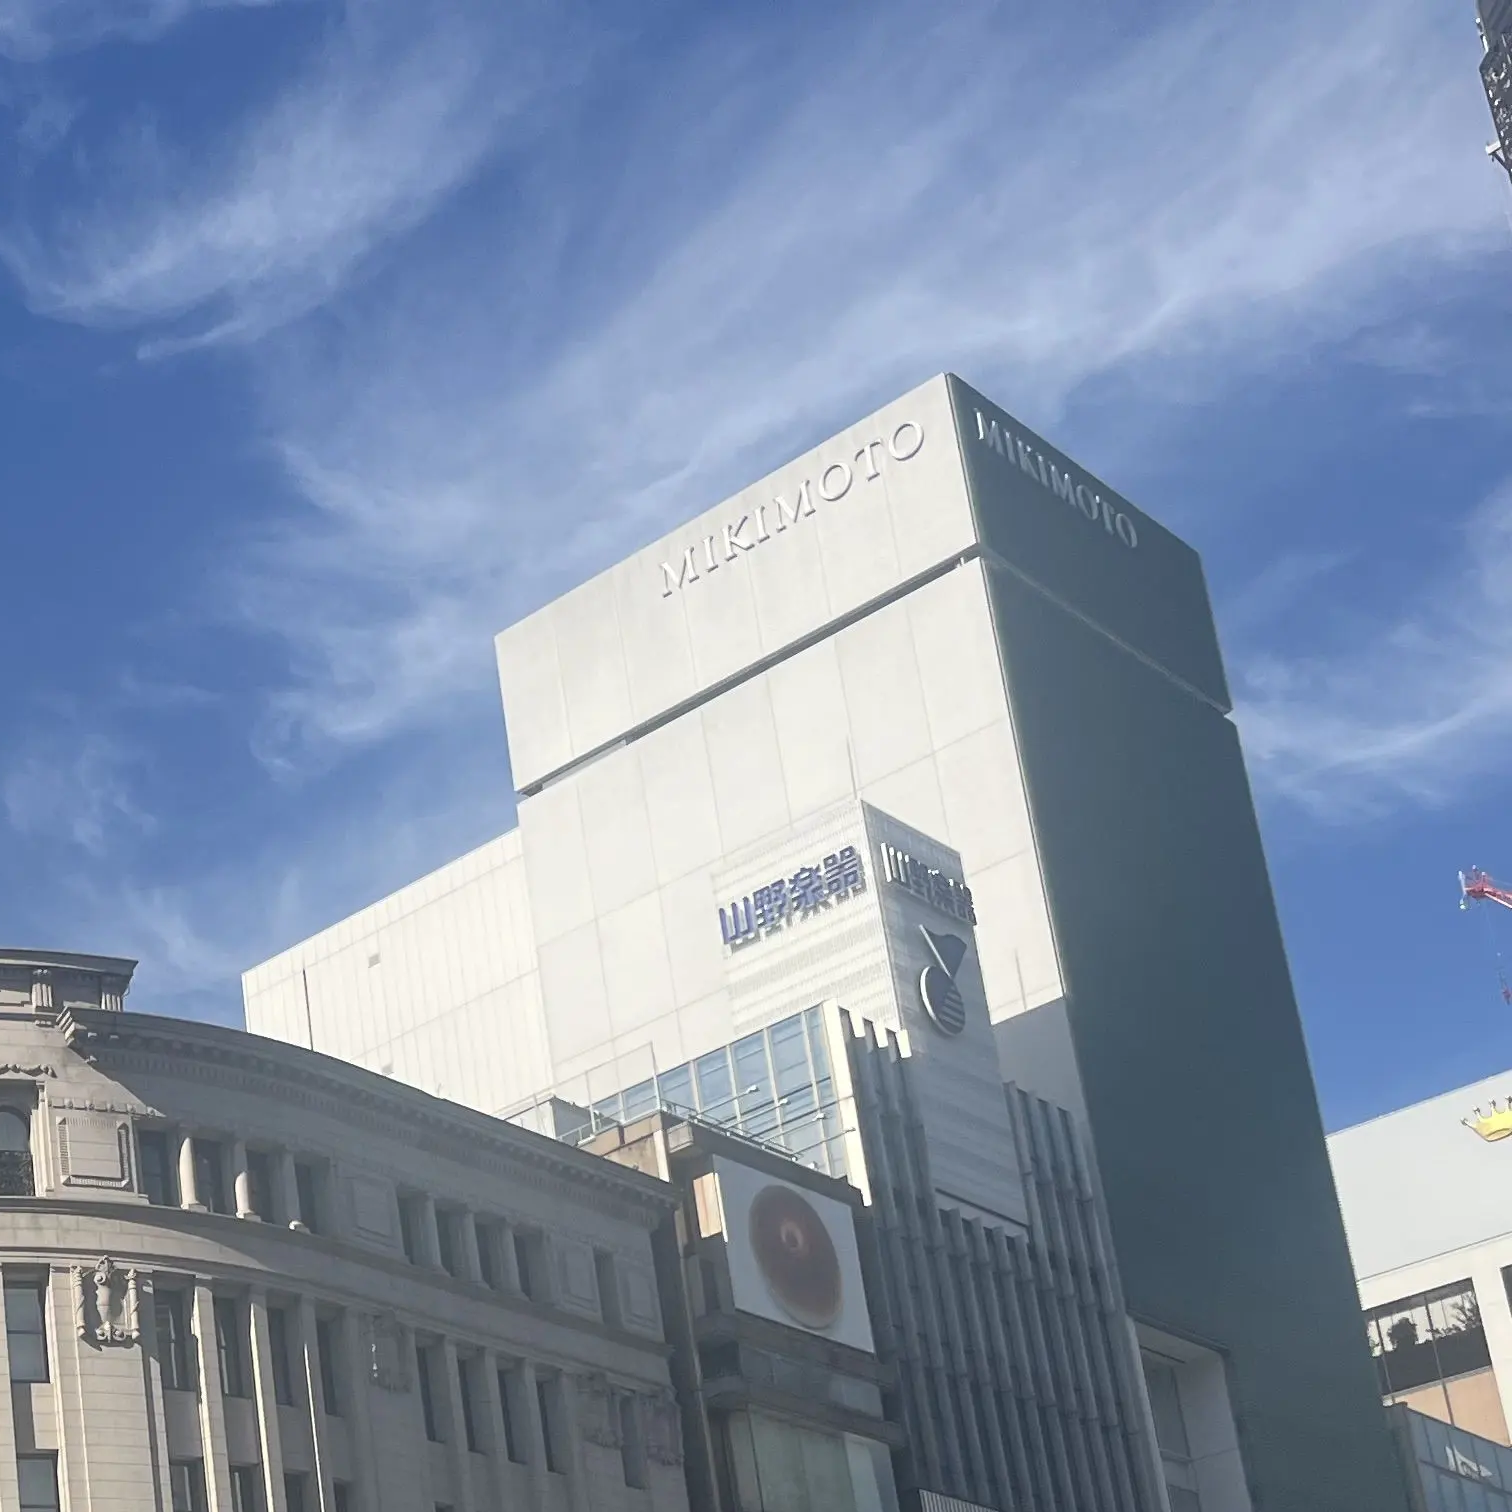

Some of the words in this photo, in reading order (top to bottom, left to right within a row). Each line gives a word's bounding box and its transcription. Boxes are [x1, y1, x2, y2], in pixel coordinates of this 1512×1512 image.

[659, 420, 925, 598] MIKIMOTO
[974, 408, 1138, 548] MIKIMOTO
[719, 845, 861, 944] 山野楽器
